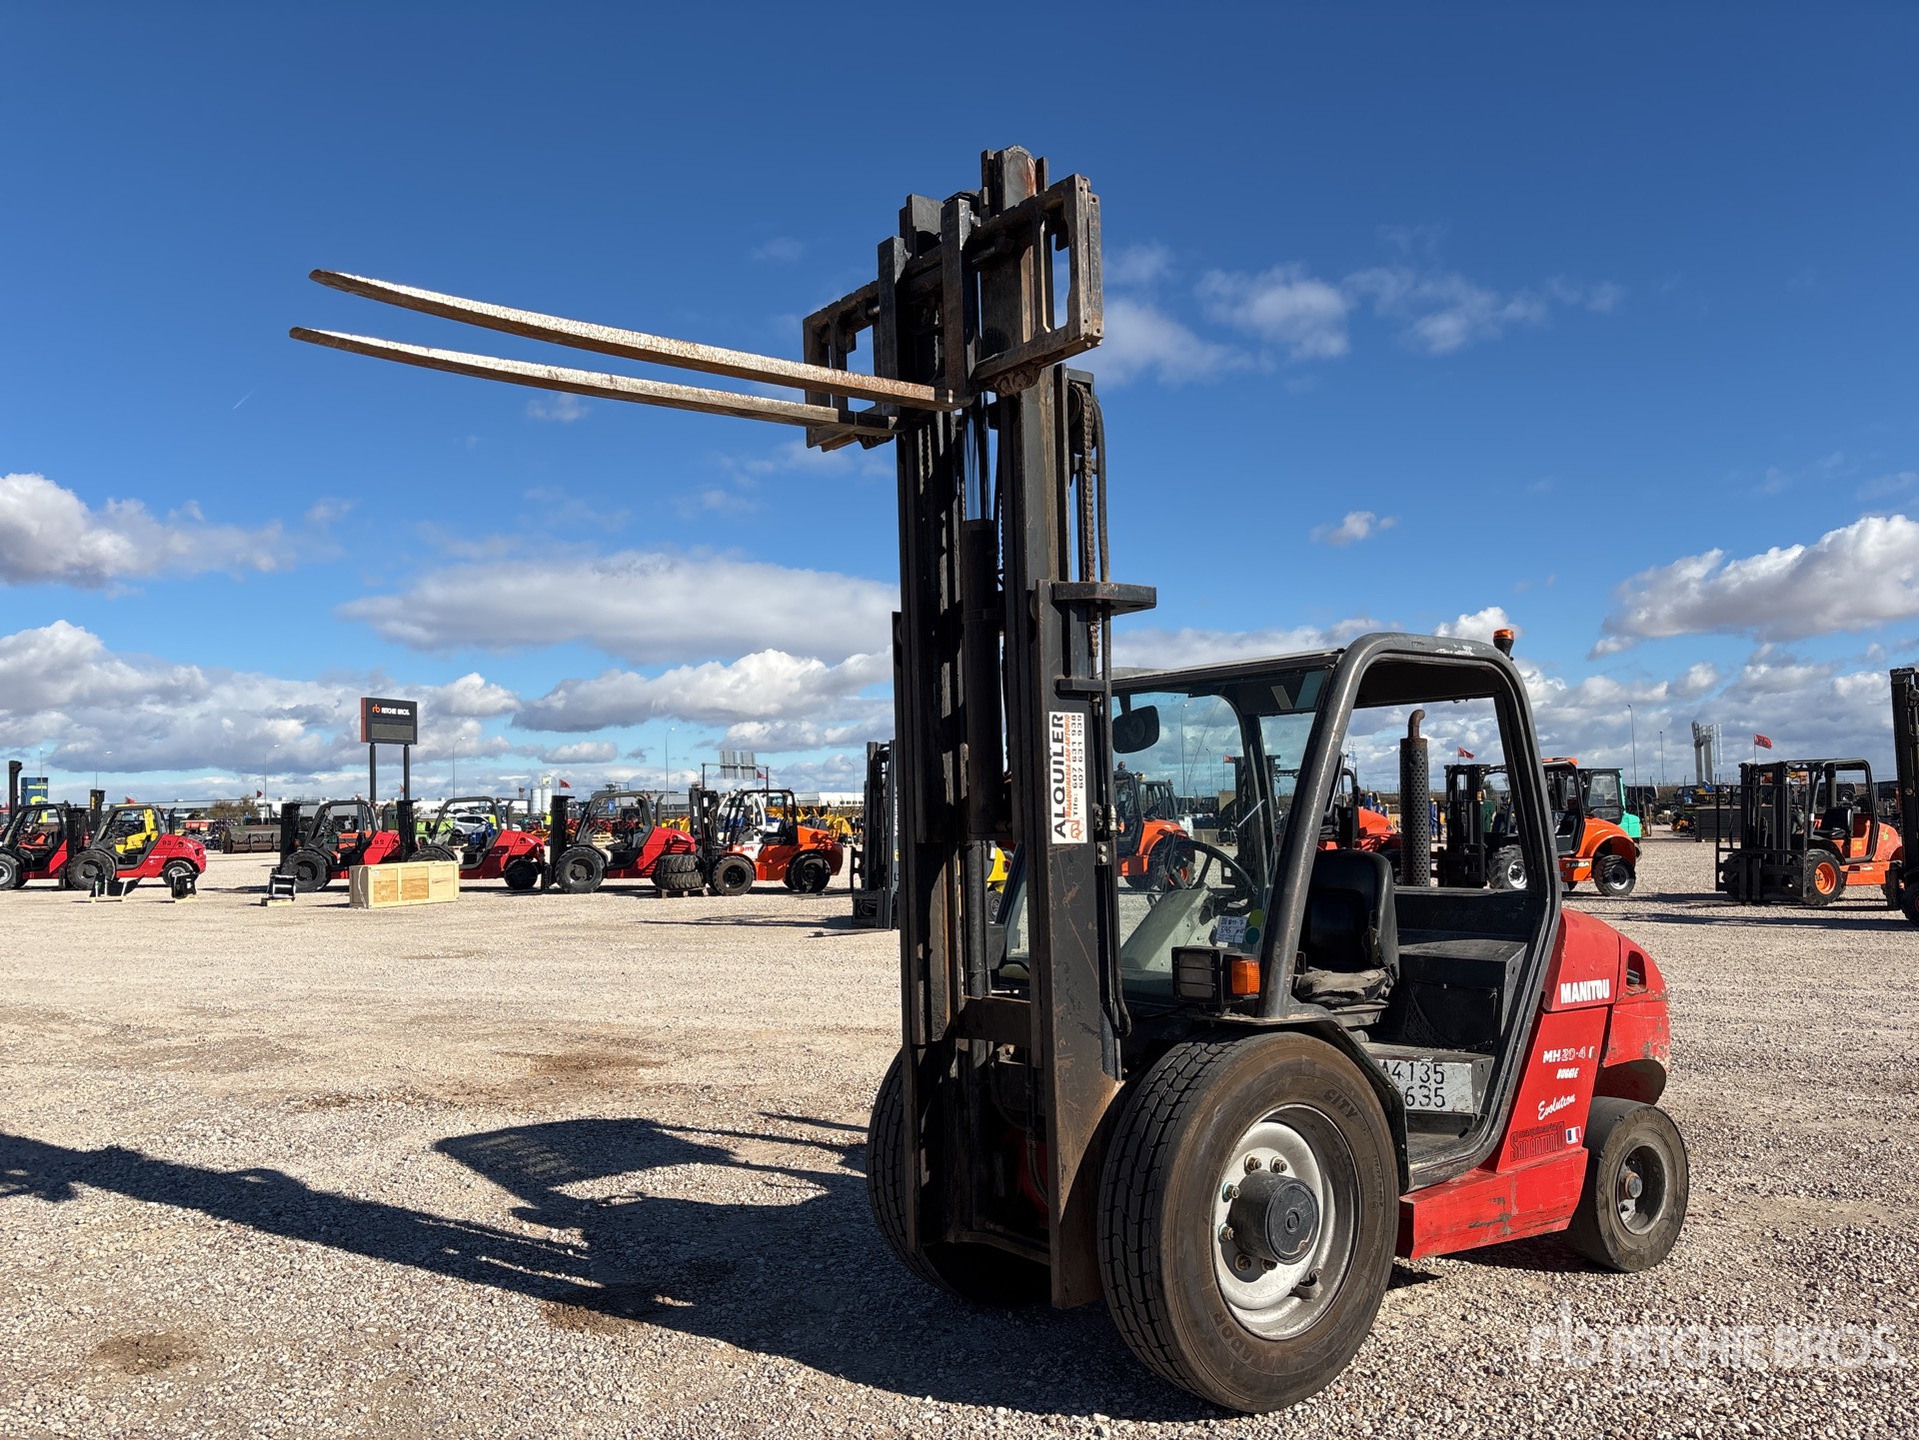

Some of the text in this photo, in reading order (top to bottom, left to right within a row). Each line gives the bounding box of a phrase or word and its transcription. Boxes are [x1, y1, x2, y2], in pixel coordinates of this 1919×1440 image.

[1051, 713, 1066, 839] ALQUILER
[1560, 978, 1610, 1004] MANITOU
[1323, 1088, 1359, 1120] CITY
[1537, 1094, 1576, 1121] Evolution
